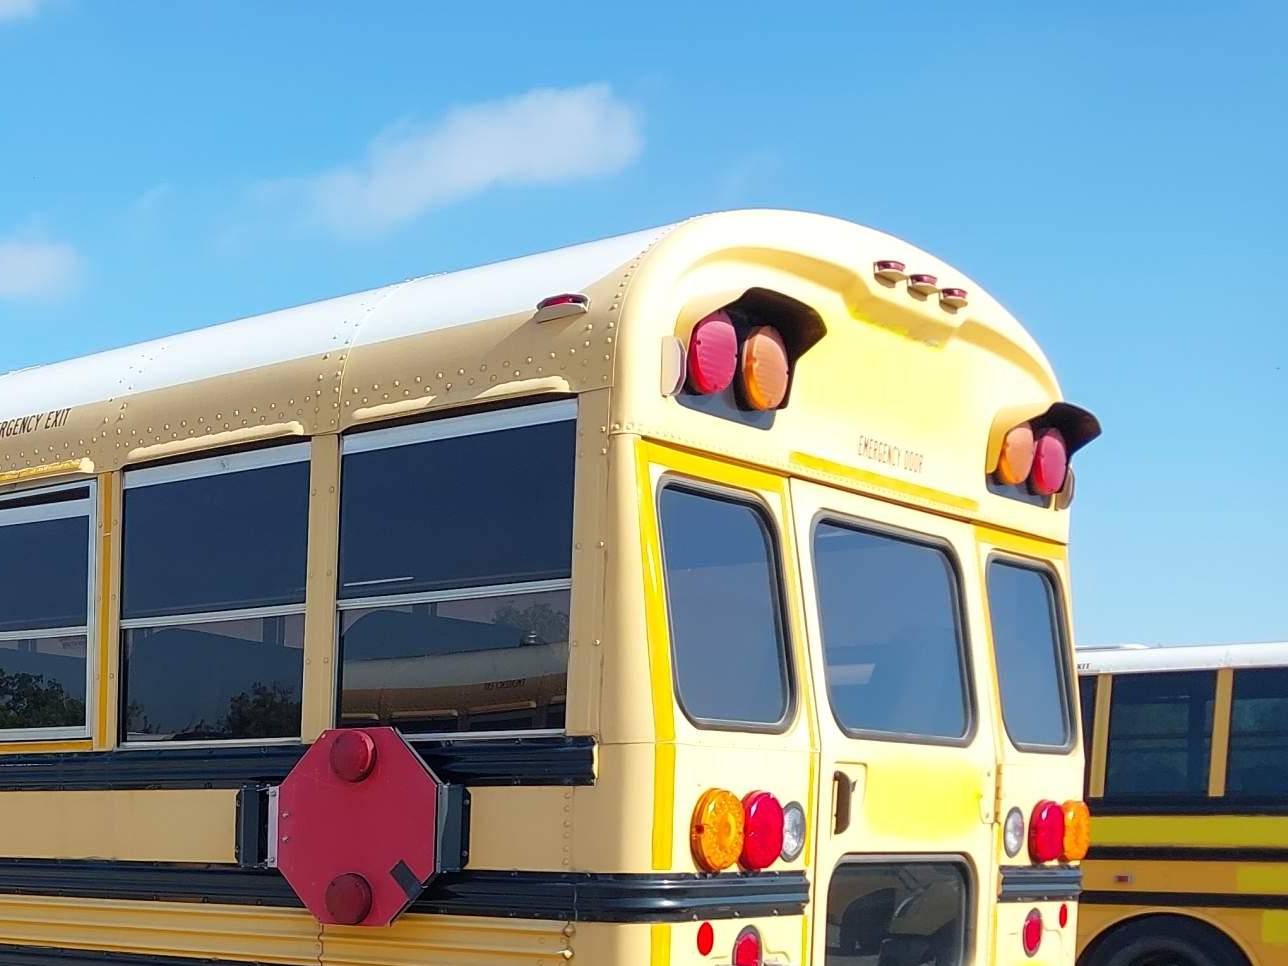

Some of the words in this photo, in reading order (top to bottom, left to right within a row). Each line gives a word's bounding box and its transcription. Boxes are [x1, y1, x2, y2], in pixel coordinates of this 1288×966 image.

[45, 408, 72, 429] EXIT
[858, 434, 903, 468] EMERGENCY
[903, 450, 924, 473] DOOR
